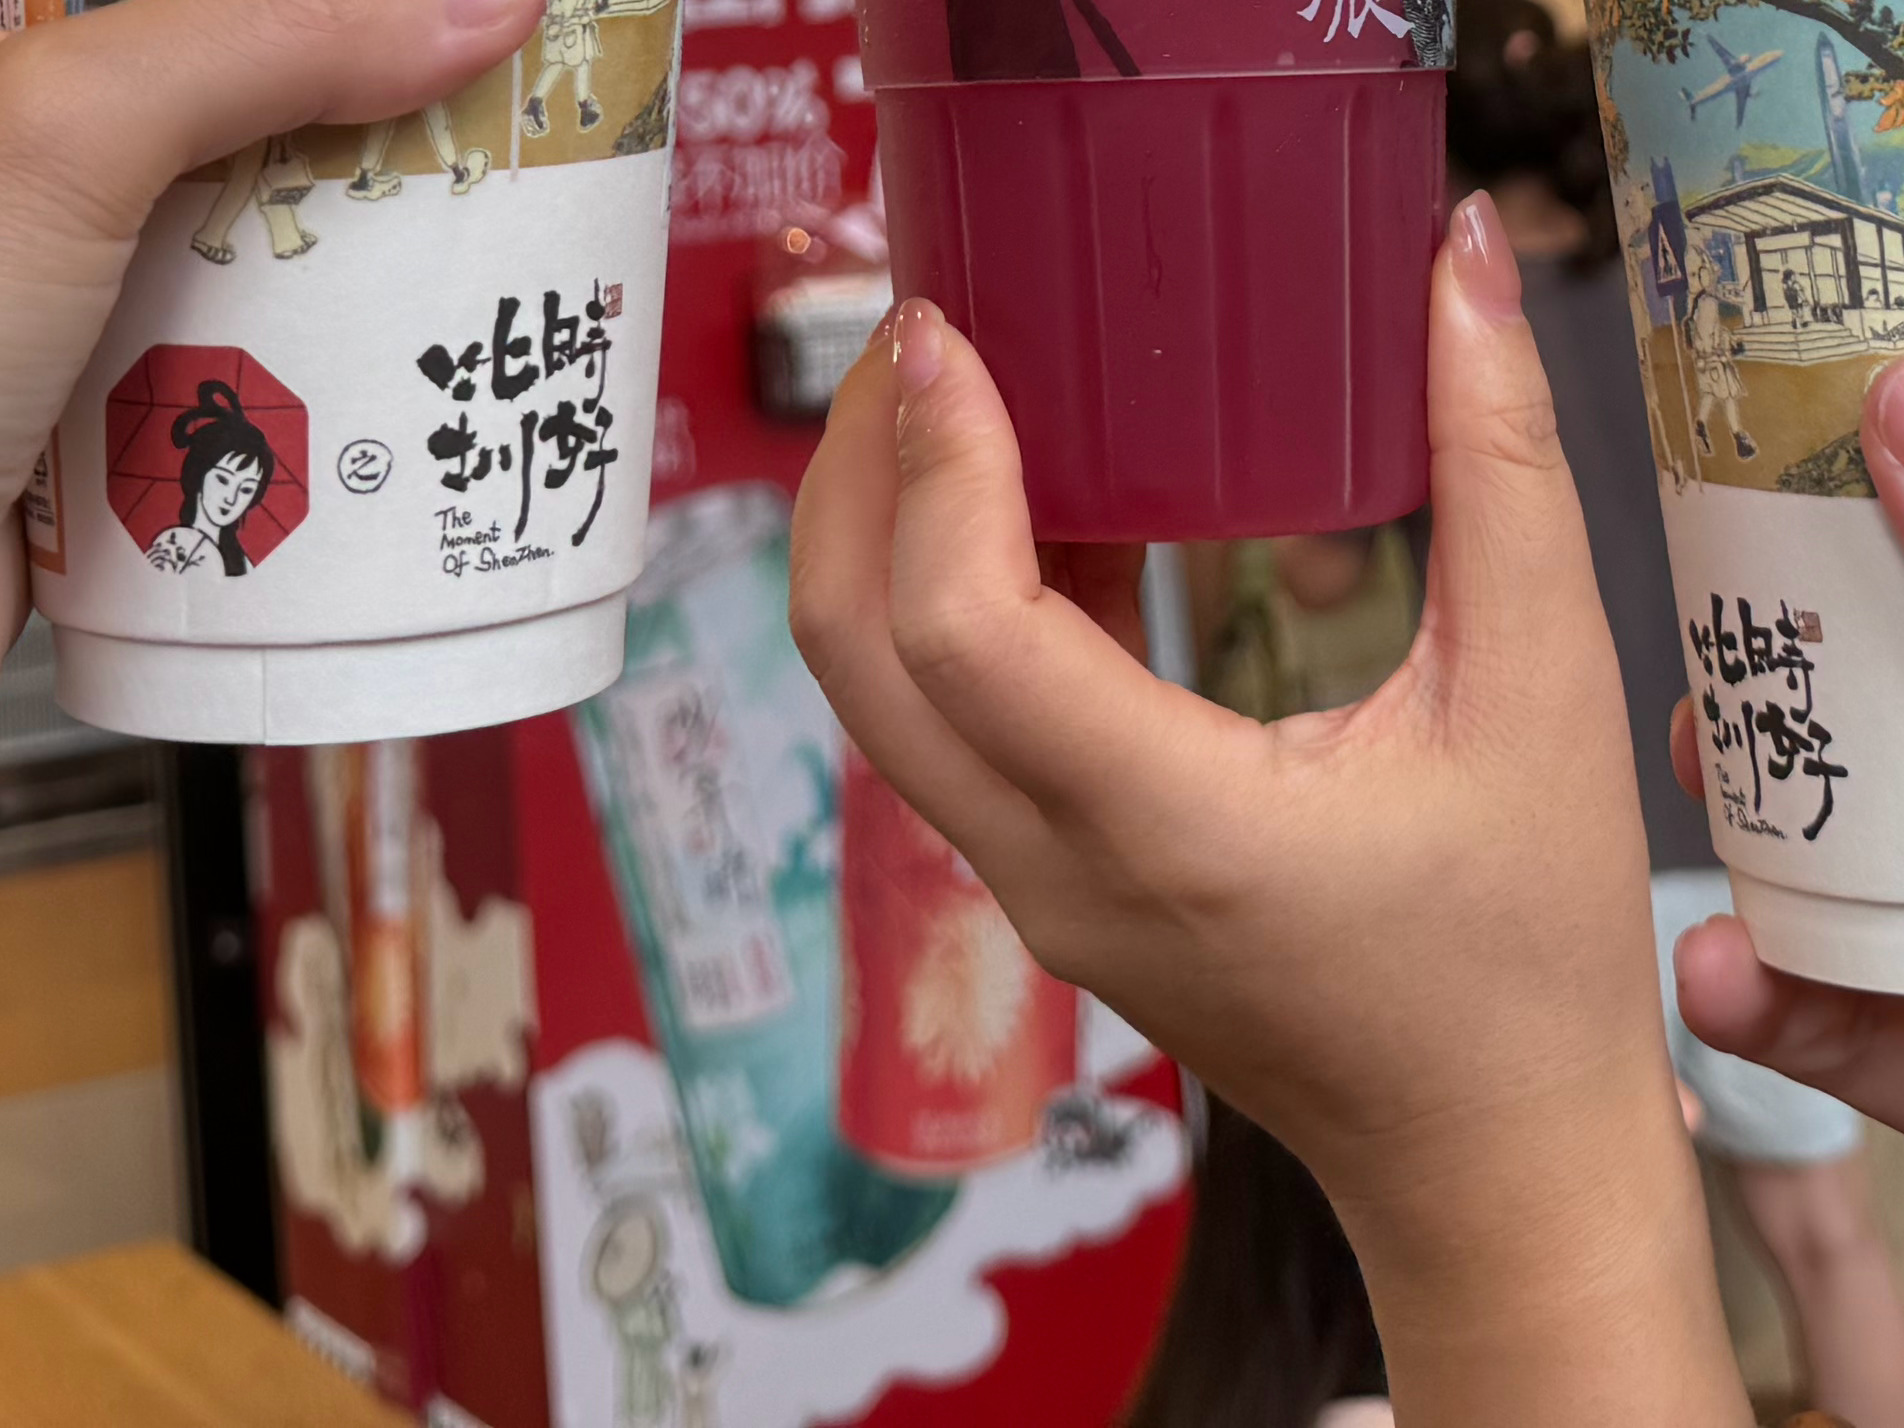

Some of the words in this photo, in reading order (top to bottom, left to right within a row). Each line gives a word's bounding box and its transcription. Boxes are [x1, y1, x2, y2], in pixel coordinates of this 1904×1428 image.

[434, 506, 473, 532] The
[439, 520, 501, 550] Moment
[442, 547, 470, 577] Of
